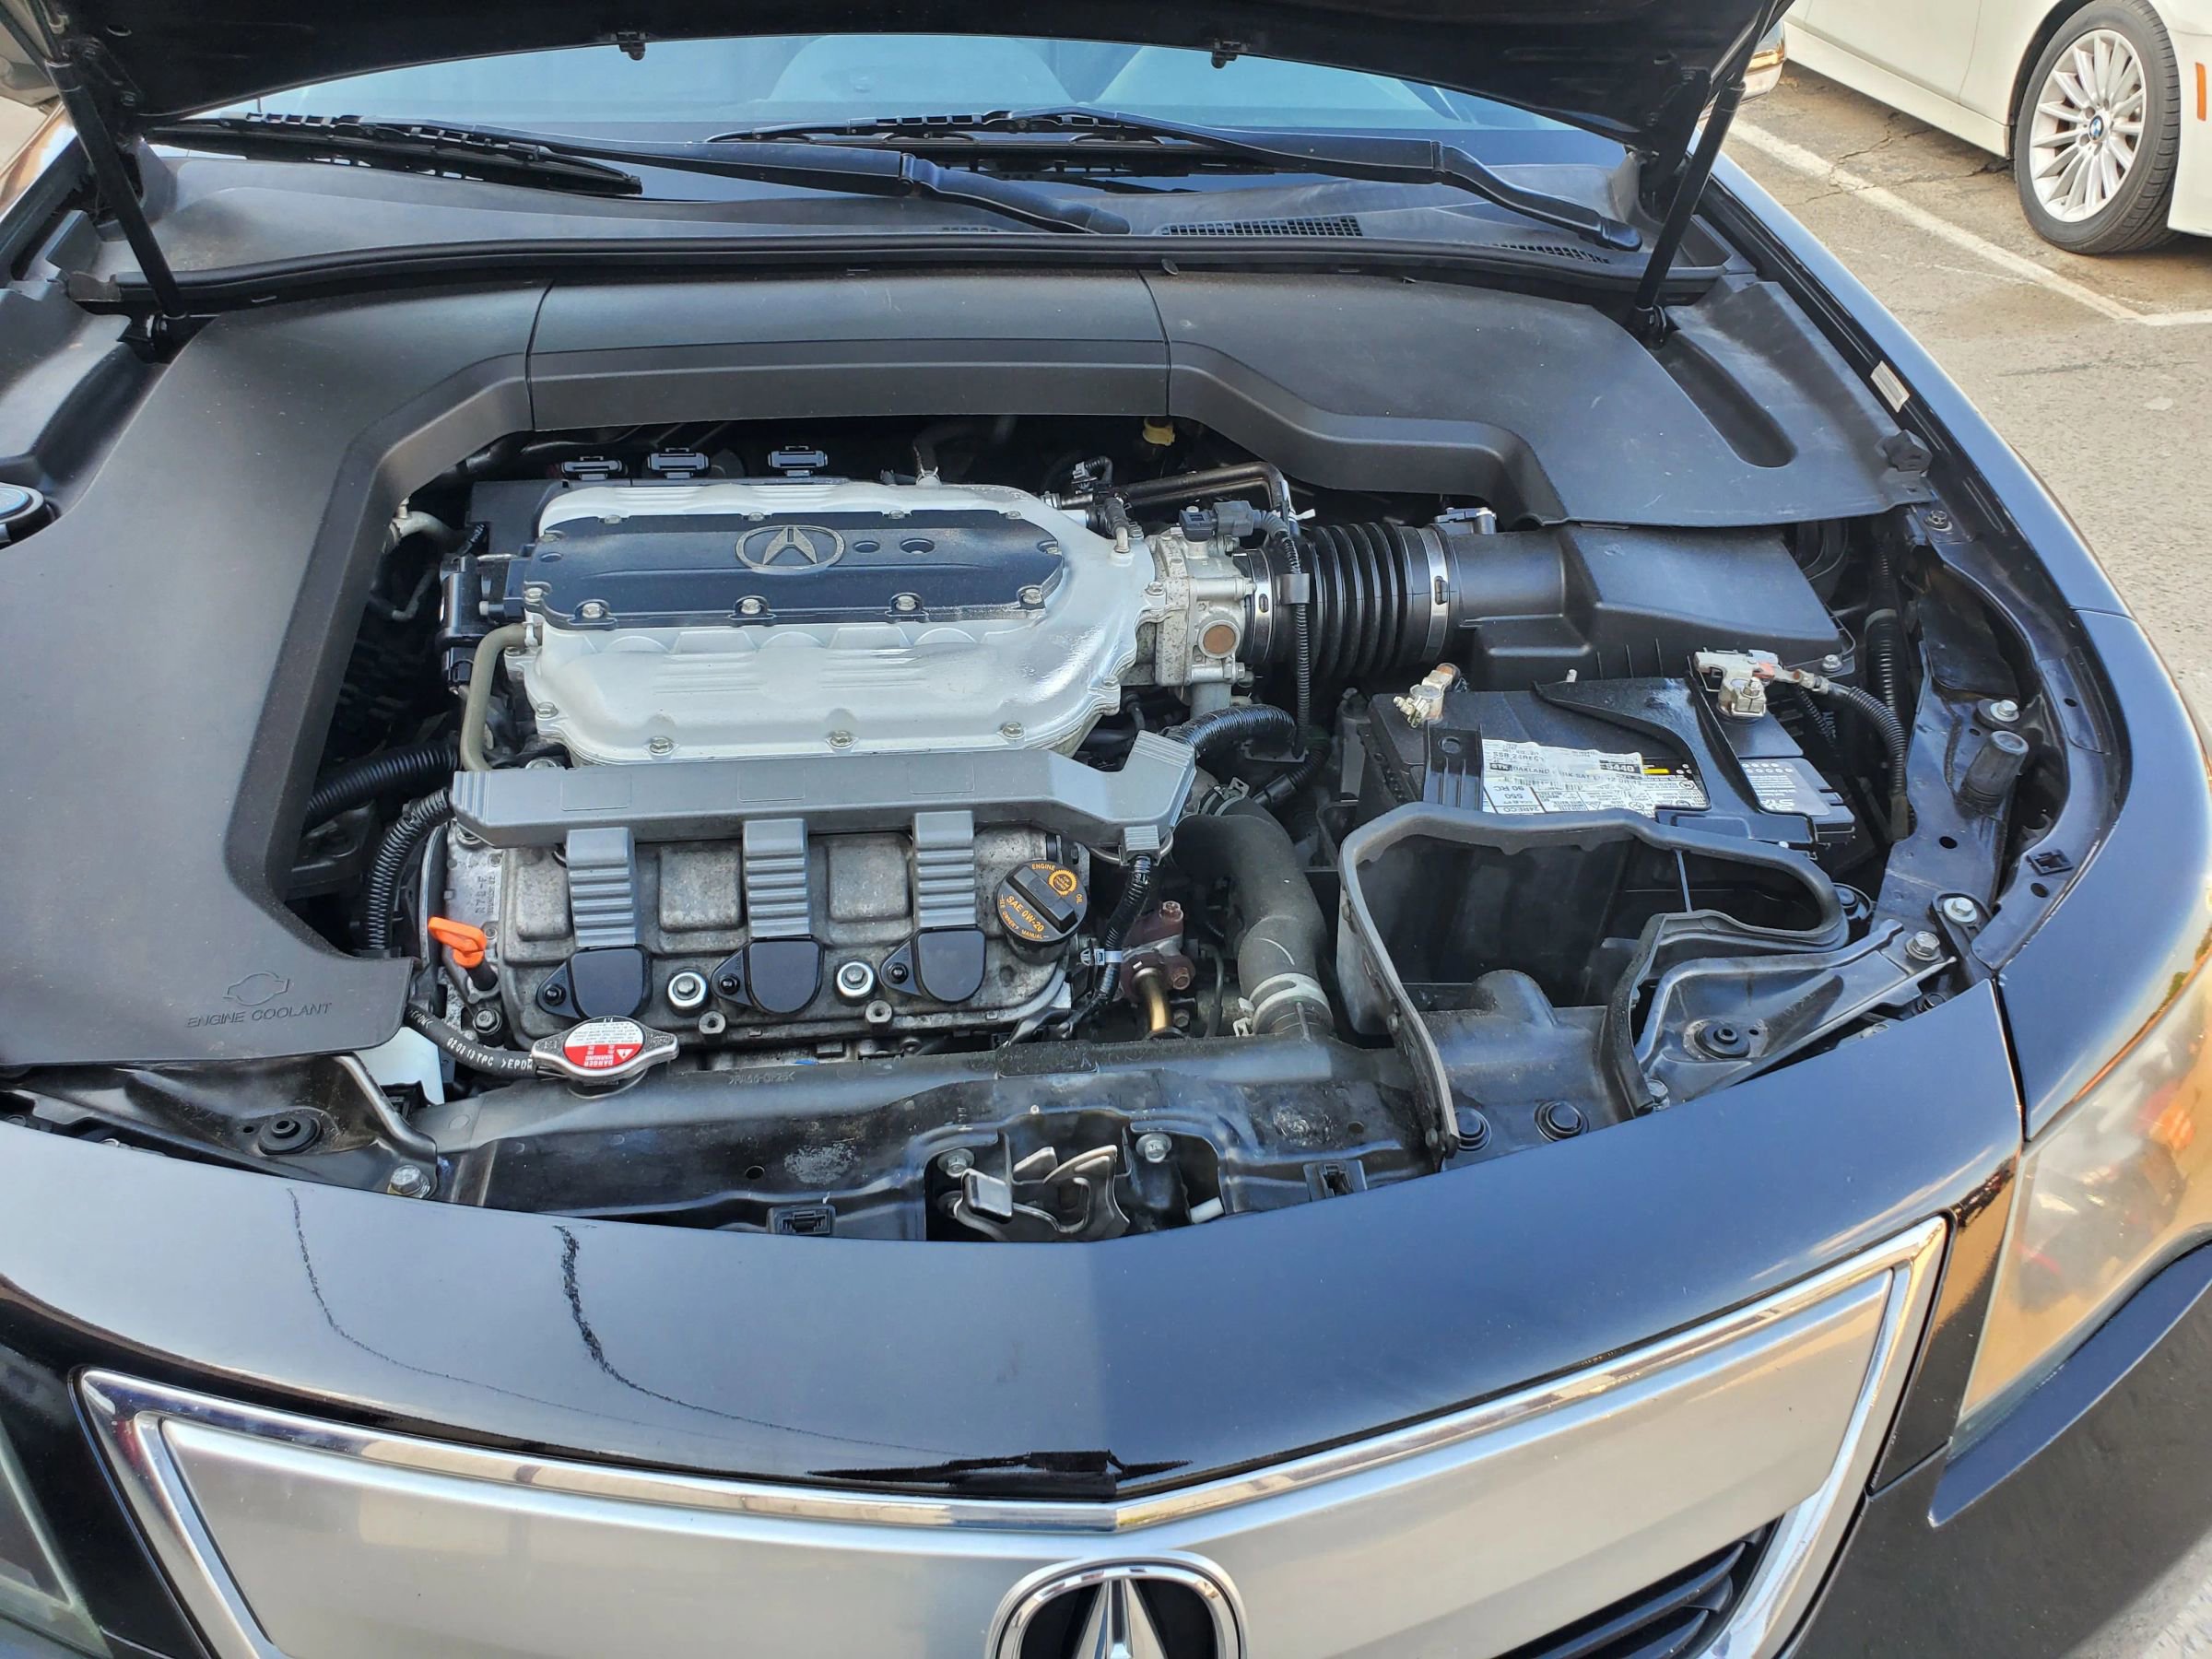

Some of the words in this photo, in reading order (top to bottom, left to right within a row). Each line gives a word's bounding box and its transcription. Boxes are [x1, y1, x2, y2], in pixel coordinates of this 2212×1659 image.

[1006, 896, 1022, 913] SAE
[1021, 910, 1045, 933] 0W-20
[1021, 929, 1043, 939] MANUAL
[185, 1010, 246, 1029] ENGINE
[251, 1002, 332, 1021] COOLANT
[476, 1052, 494, 1066] TPC
